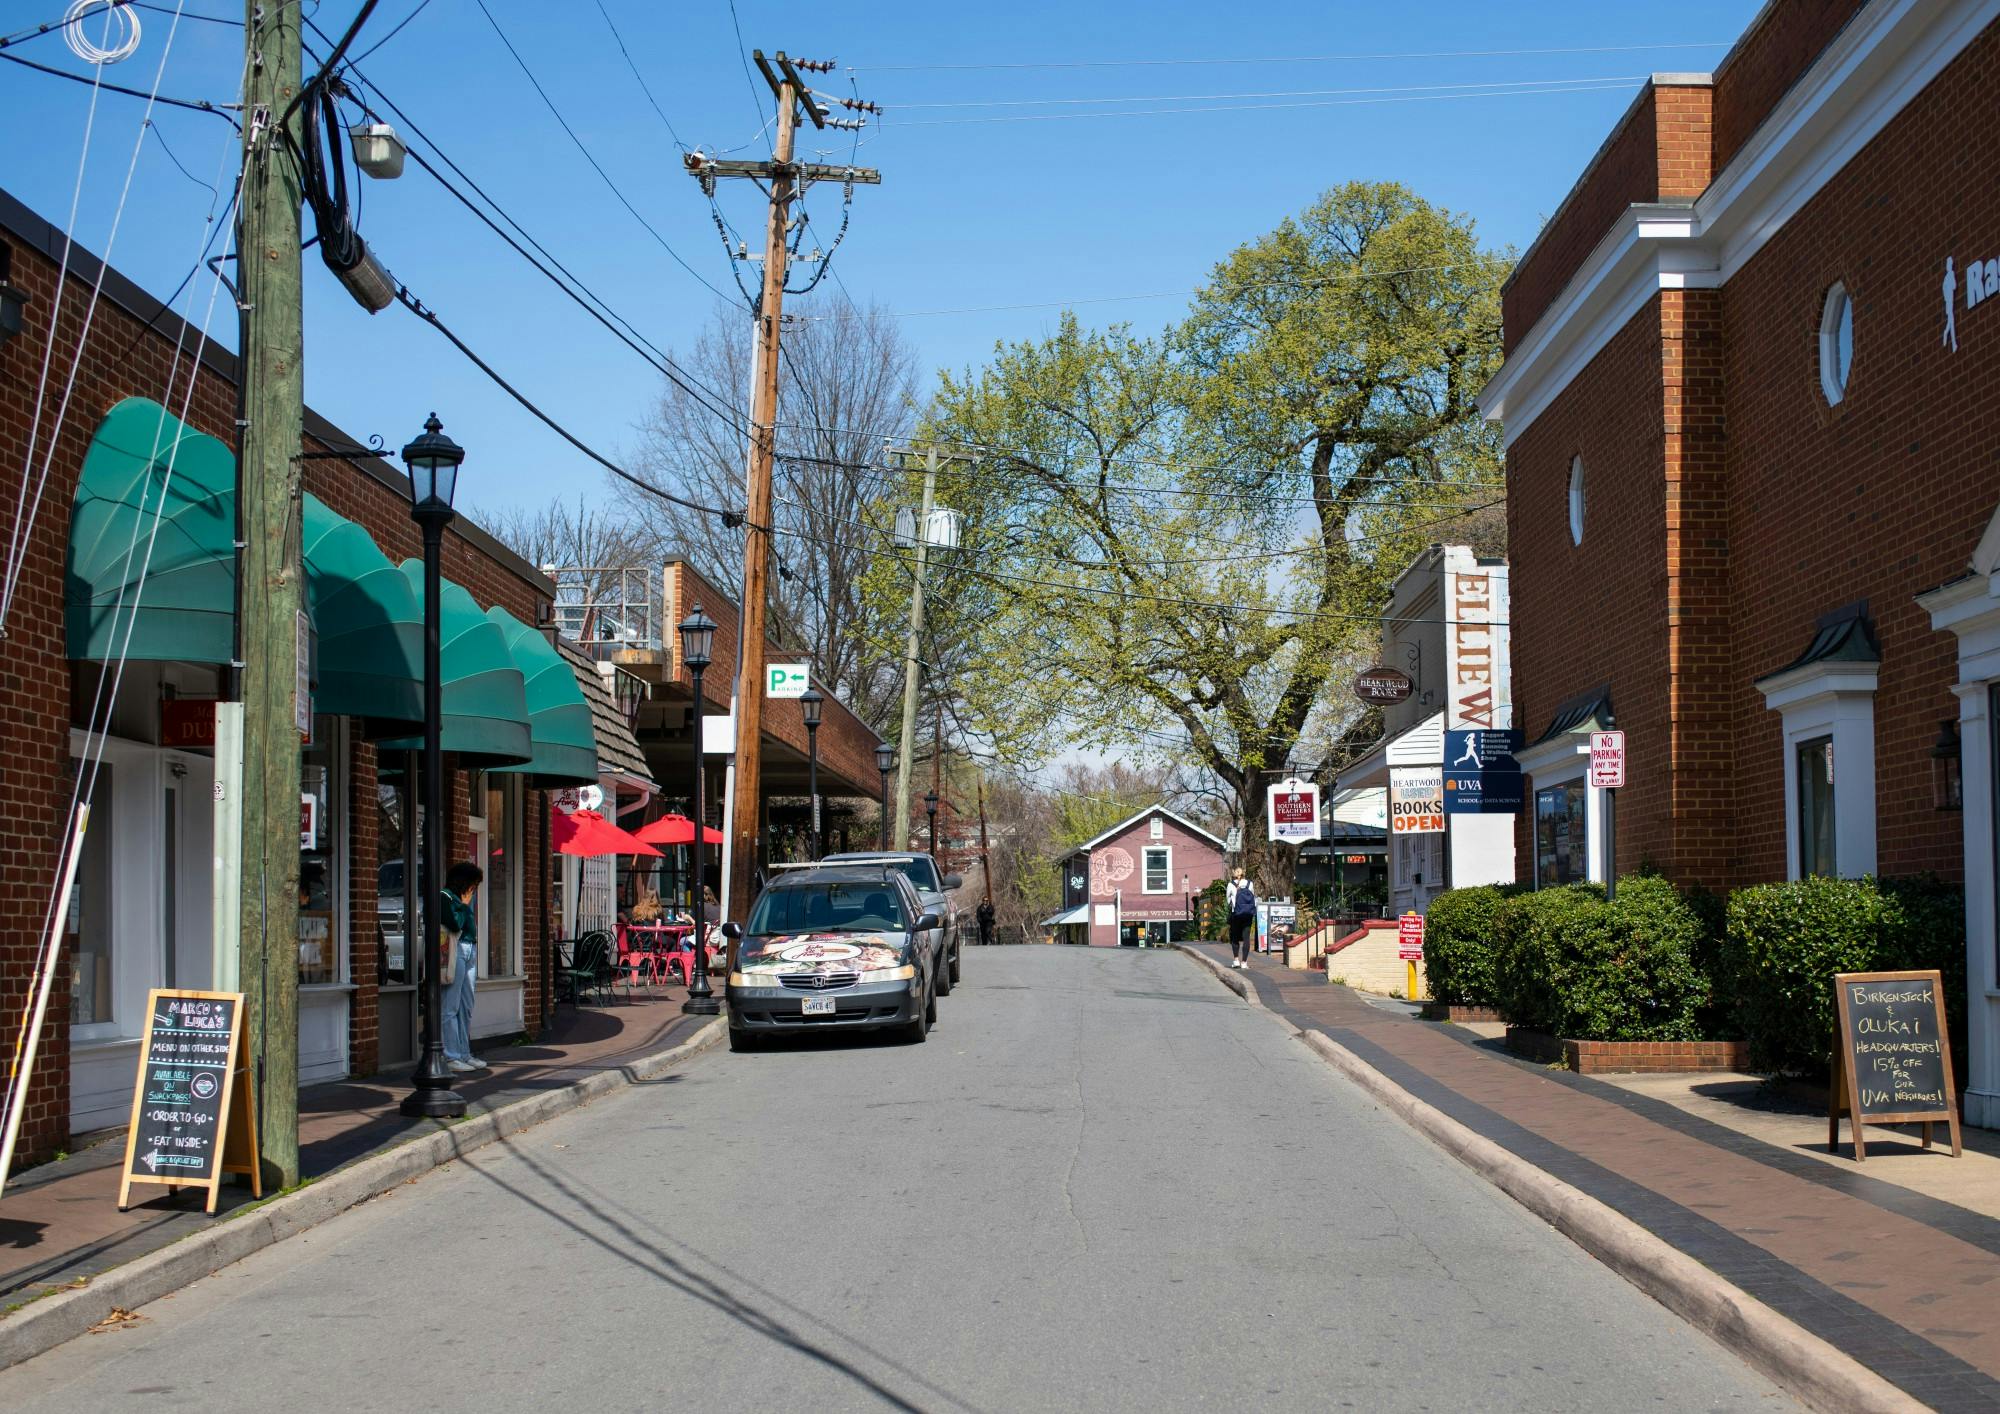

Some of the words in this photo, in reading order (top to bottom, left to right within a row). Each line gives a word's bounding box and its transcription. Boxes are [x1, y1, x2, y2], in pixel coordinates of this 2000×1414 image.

[1966, 256, 2000, 311] Ra
[1360, 678, 1409, 689] HEARTWOOD
[1371, 687, 1398, 697] BOOKS
[1601, 737, 1613, 748] NO
[1593, 749, 1622, 760] PARKING
[1594, 761, 1605, 769] ANY
[1608, 760, 1620, 769] TIME
[1393, 778, 1441, 788] HEARTWOOD
[1458, 780, 1482, 791] UVA
[1393, 800, 1443, 815] BOOKS
[1394, 815, 1443, 831] OPEN
[168, 1001, 211, 1016] MARCO
[184, 1014, 225, 1029] LUCA'S
[152, 1042, 178, 1052] MENU
[179, 1043, 190, 1052] ON
[191, 1043, 214, 1053] OTHER
[1873, 1057, 1900, 1072] 15%
[1902, 1058, 1923, 1068] OFF
[154, 1070, 192, 1079] AVAILABLE
[1893, 1069, 1911, 1080] FOR
[163, 1081, 176, 1089] ON
[1894, 1080, 1916, 1089] OUR
[1862, 1089, 1890, 1107] UVA
[152, 1110, 179, 1122] ORDER
[179, 1111, 207, 1125] TO-GO
[153, 1135, 172, 1146] EAT
[175, 1136, 202, 1148] INSIDE
